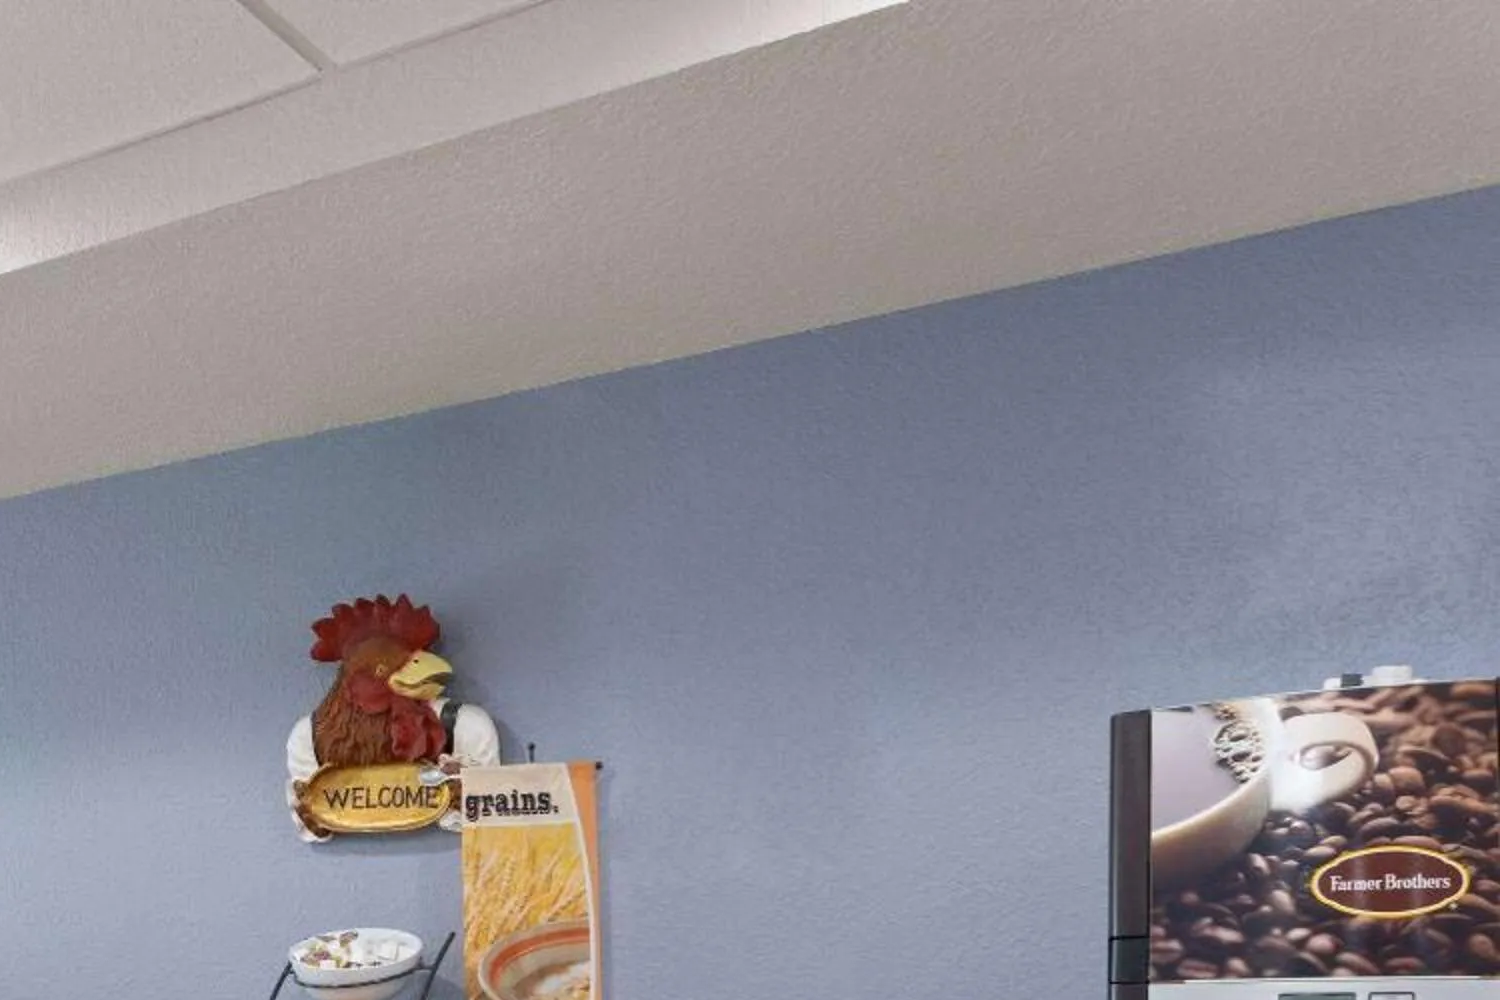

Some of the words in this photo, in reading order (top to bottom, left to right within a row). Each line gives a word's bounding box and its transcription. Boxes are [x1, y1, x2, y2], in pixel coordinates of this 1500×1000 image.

[323, 786, 441, 809] WELCOME
[464, 789, 560, 822] grains.
[1329, 875, 1383, 892] Farmer
[1384, 873, 1452, 890] Brothers
